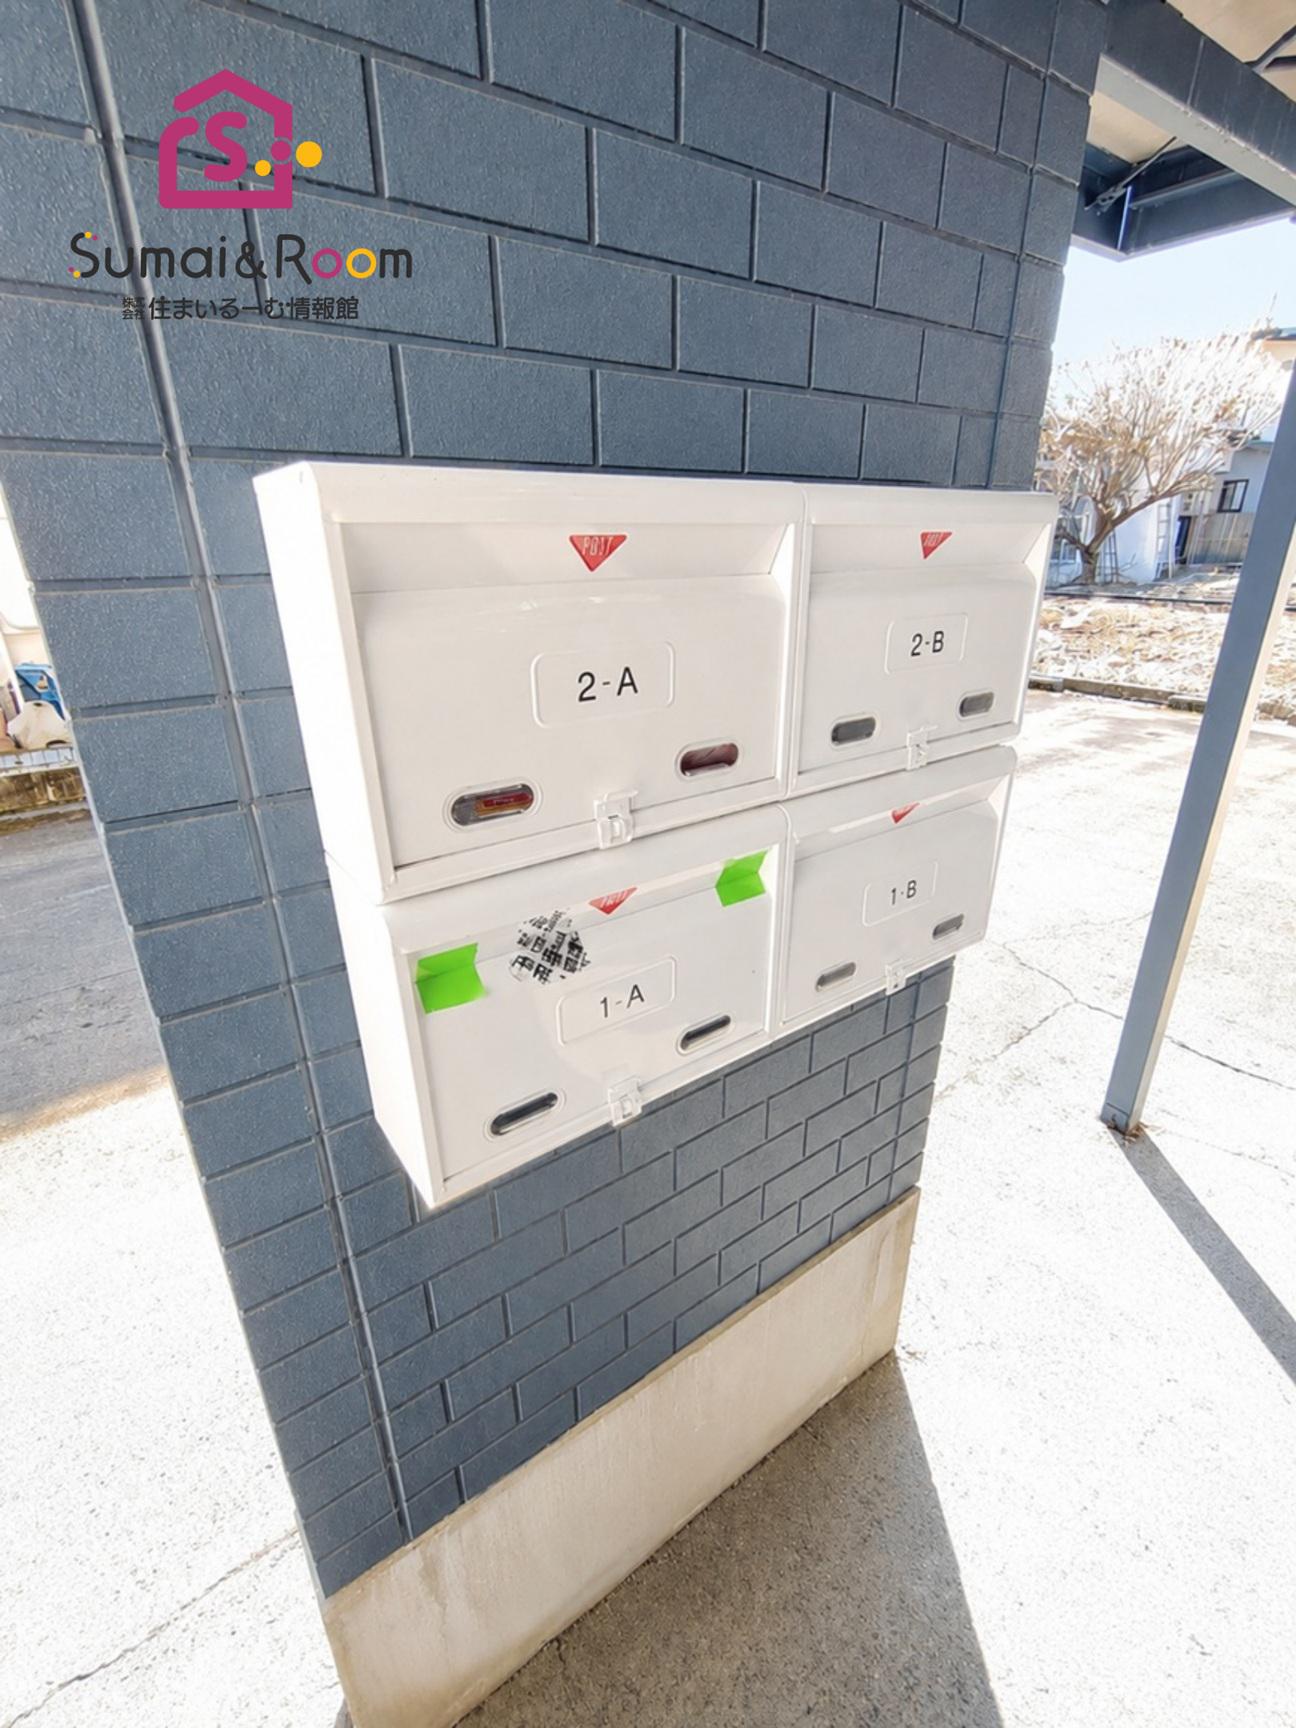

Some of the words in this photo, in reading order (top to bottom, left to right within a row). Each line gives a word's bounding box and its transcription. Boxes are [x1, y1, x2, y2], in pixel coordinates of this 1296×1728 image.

[911, 630, 944, 657] 2-B
[577, 666, 639, 702] 2-A
[600, 984, 645, 1018] 1-A
